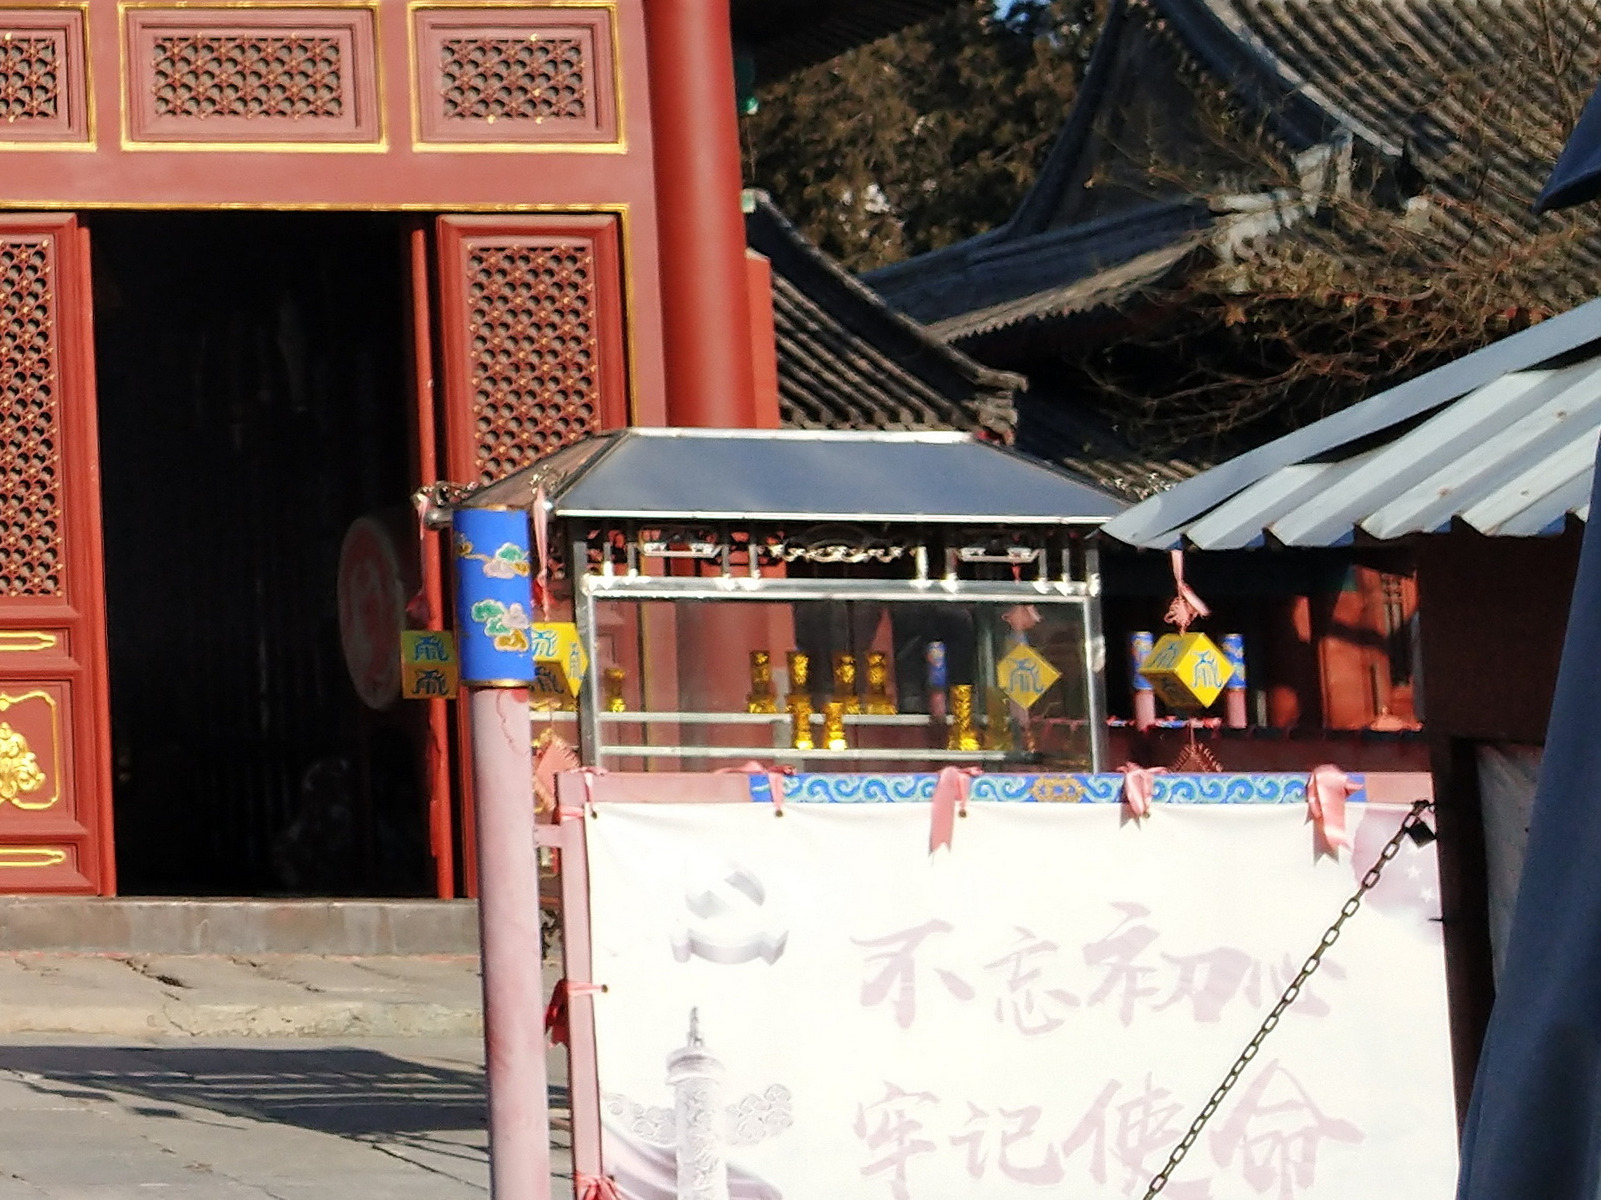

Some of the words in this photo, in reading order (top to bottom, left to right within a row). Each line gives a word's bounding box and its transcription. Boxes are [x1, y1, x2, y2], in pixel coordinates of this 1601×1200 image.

[849, 901, 1347, 1036] 不忘初心
[853, 1058, 1366, 1200] 牢记使命
